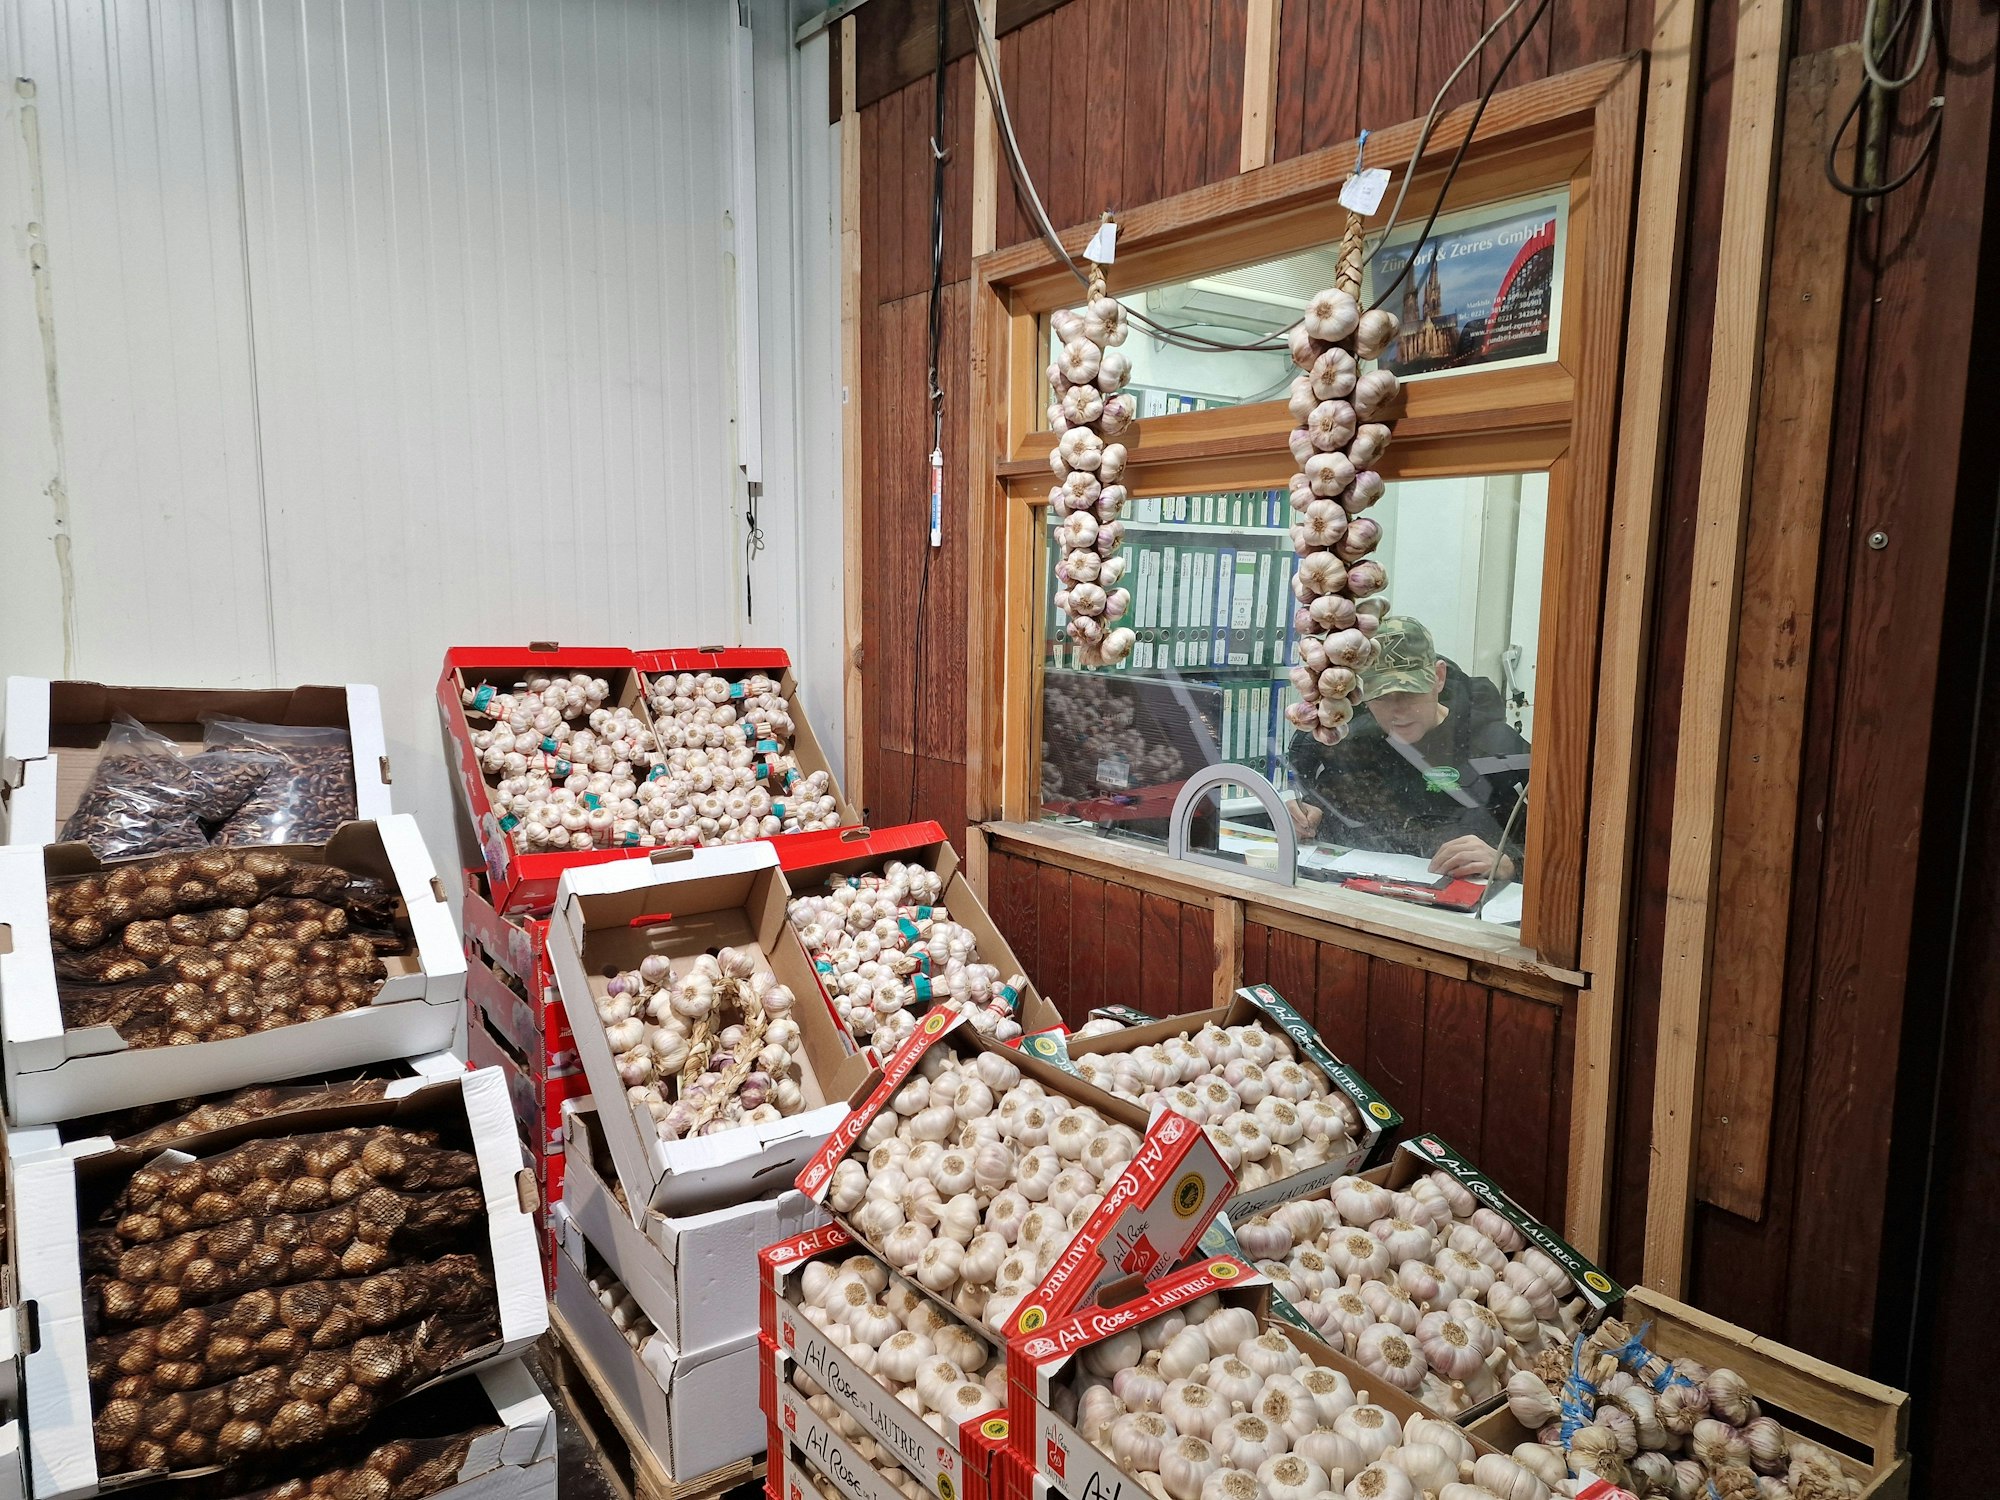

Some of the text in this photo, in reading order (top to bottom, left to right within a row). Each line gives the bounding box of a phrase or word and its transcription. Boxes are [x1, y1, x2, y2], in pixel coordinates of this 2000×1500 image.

[1381, 222, 1546, 274] Zünorf & Zerres GmbH
[1374, 631, 1410, 671] K
[1265, 1004, 1301, 1022] Ail
[1287, 1024, 1316, 1051] Rose
[1323, 1060, 1369, 1101] LAUTREC
[826, 1133, 847, 1169] Ail
[847, 1102, 877, 1138] Rose
[884, 1037, 929, 1087] LAUTREC
[1039, 1136, 1163, 1302] Ail Rose DE LAUTREC
[1277, 1174, 1333, 1202] LAUTREC
[1435, 1156, 1478, 1177] Ail
[1466, 1180, 1505, 1210] Rose
[1519, 1220, 1581, 1270] LAUTREC
[798, 1232, 823, 1257] Ail
[1113, 1220, 1150, 1272] Ail Rose
[1059, 1319, 1091, 1352] Ail
[1092, 1312, 1138, 1333] Rose
[1150, 1276, 1216, 1308] LAUTREC
[804, 1340, 827, 1377] Ail
[828, 1361, 861, 1408] Rose
[869, 1401, 926, 1469] LAUTREC
[805, 1425, 828, 1463] Ail
[829, 1448, 862, 1497] Rose
